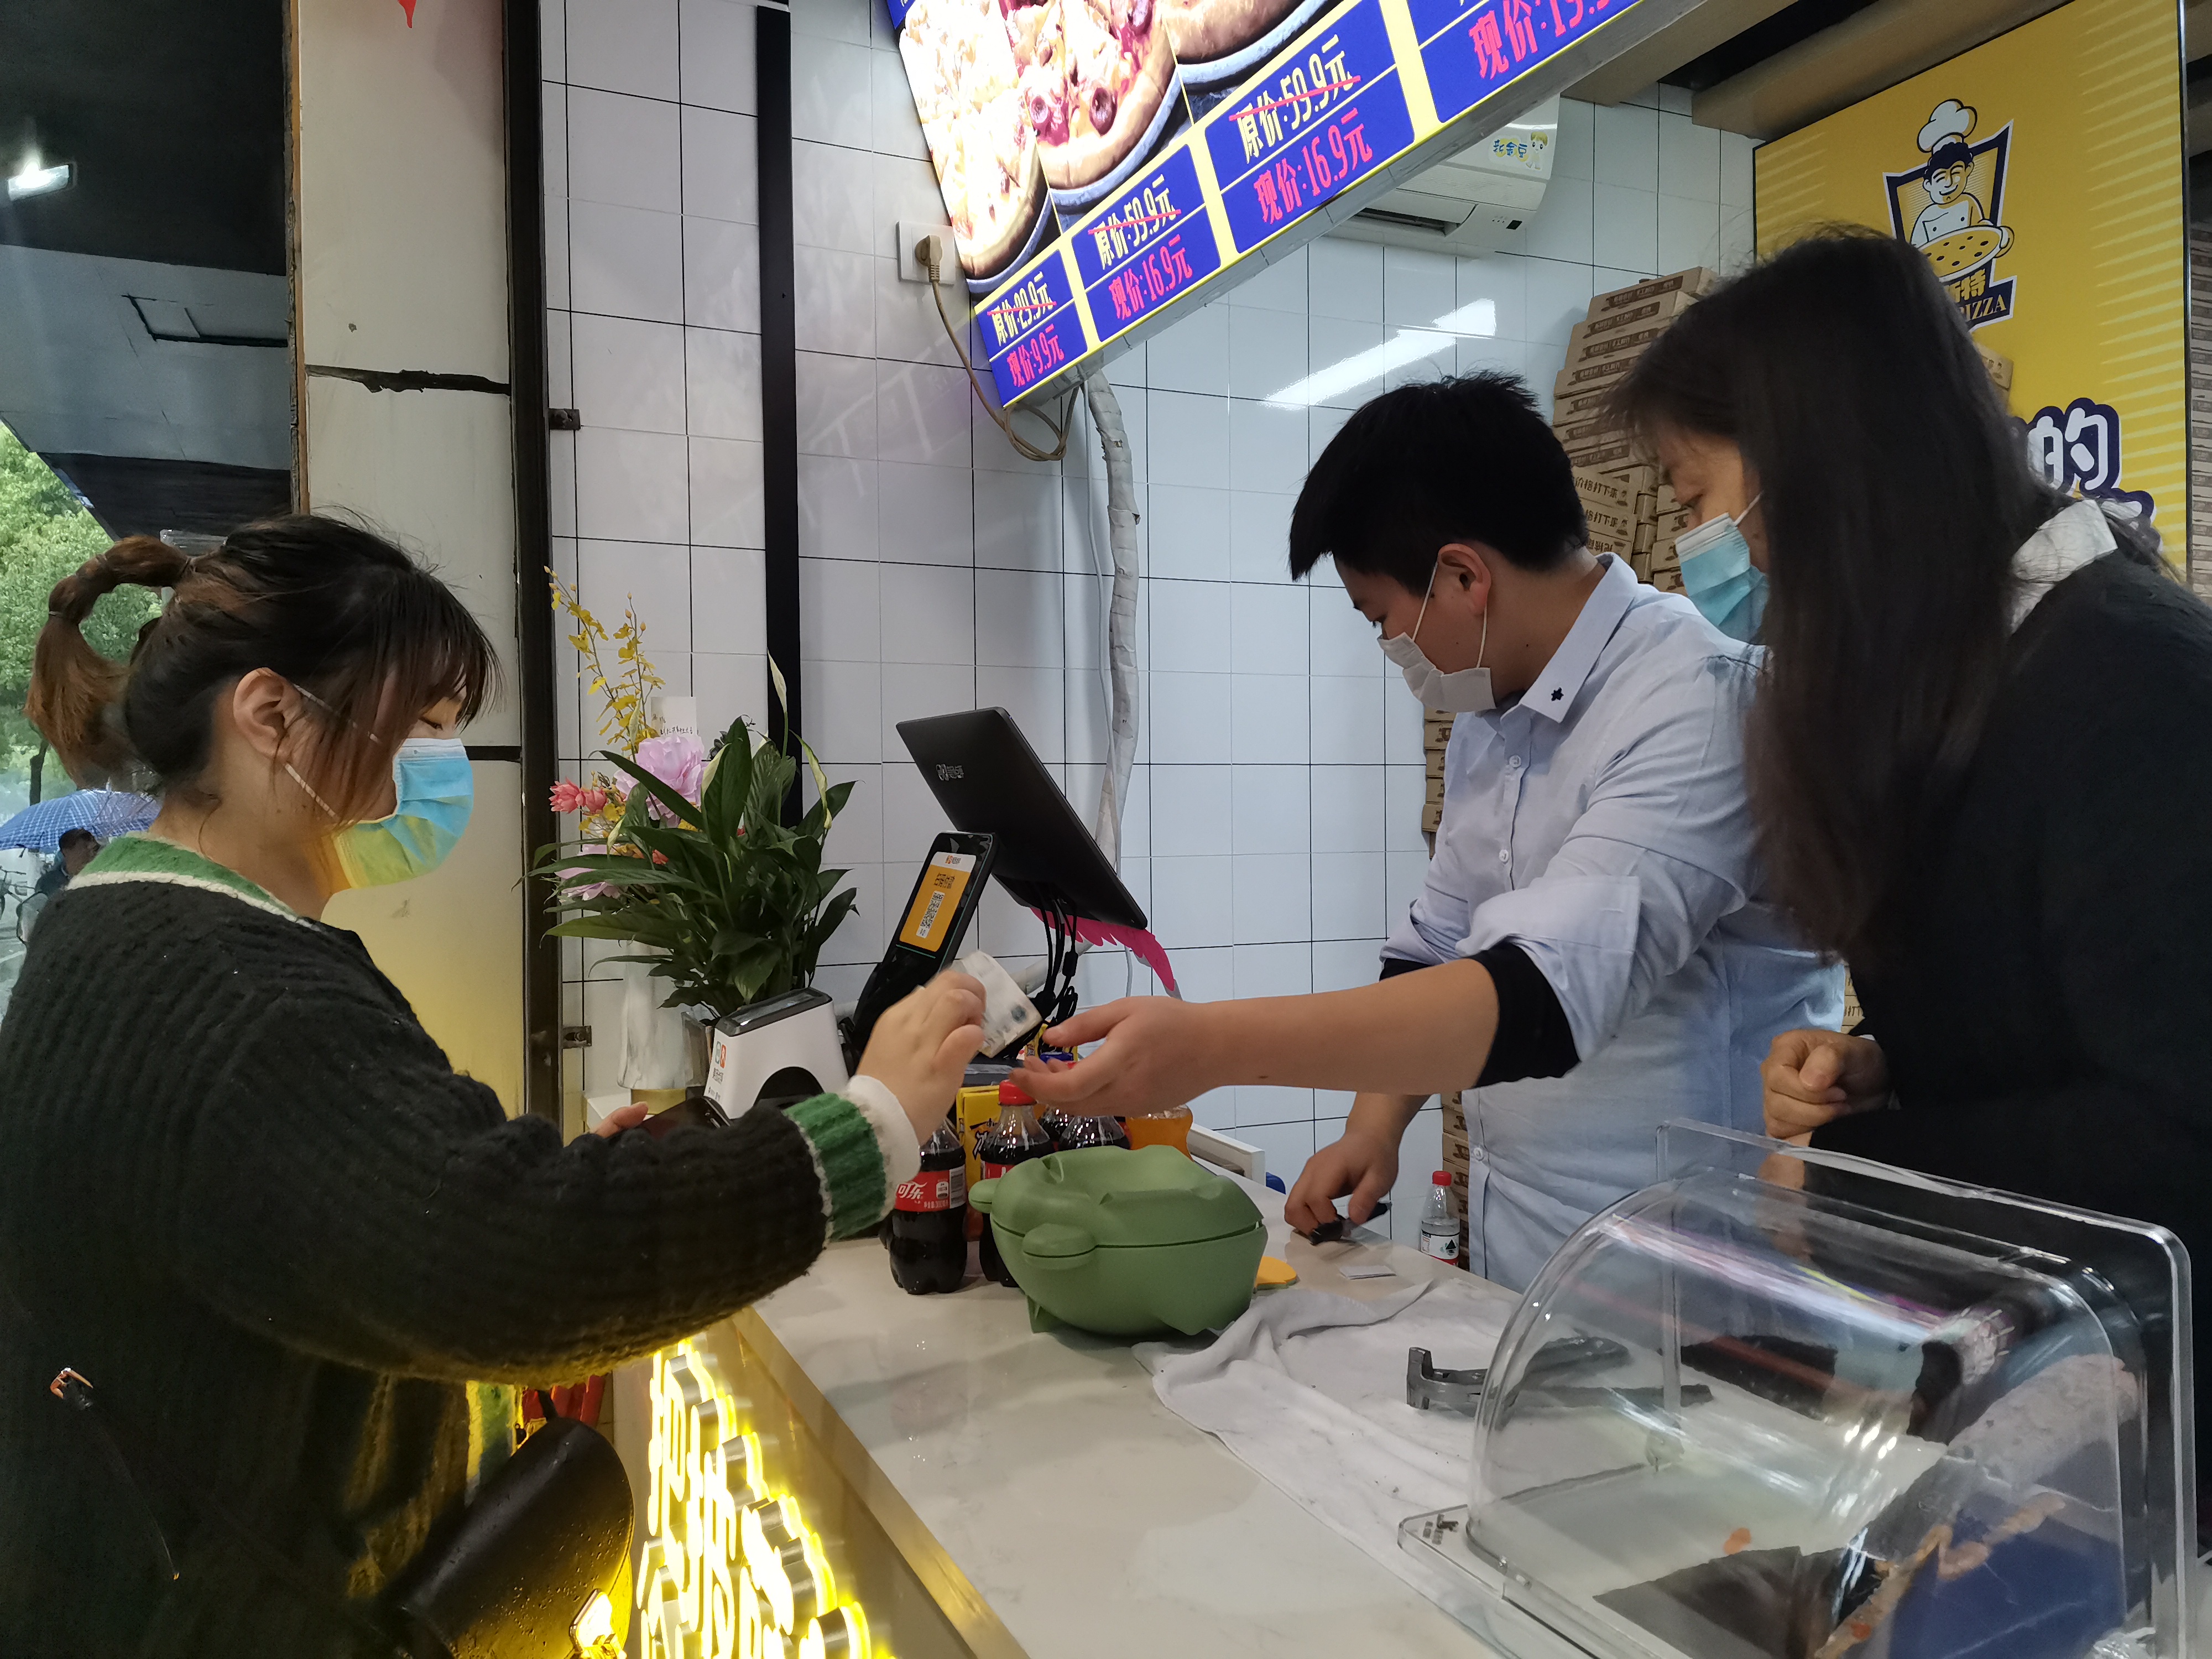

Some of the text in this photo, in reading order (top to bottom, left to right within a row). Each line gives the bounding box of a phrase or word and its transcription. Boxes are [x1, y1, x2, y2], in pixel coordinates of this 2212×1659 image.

[1237, 34, 1353, 164] 原价:59.9元
[1254, 107, 1373, 225] 现价:16.9元
[1109, 234, 1193, 320] 现价:16.9元
[1007, 324, 1065, 387] 现价:9.9元
[2027, 408, 2108, 491] 的
